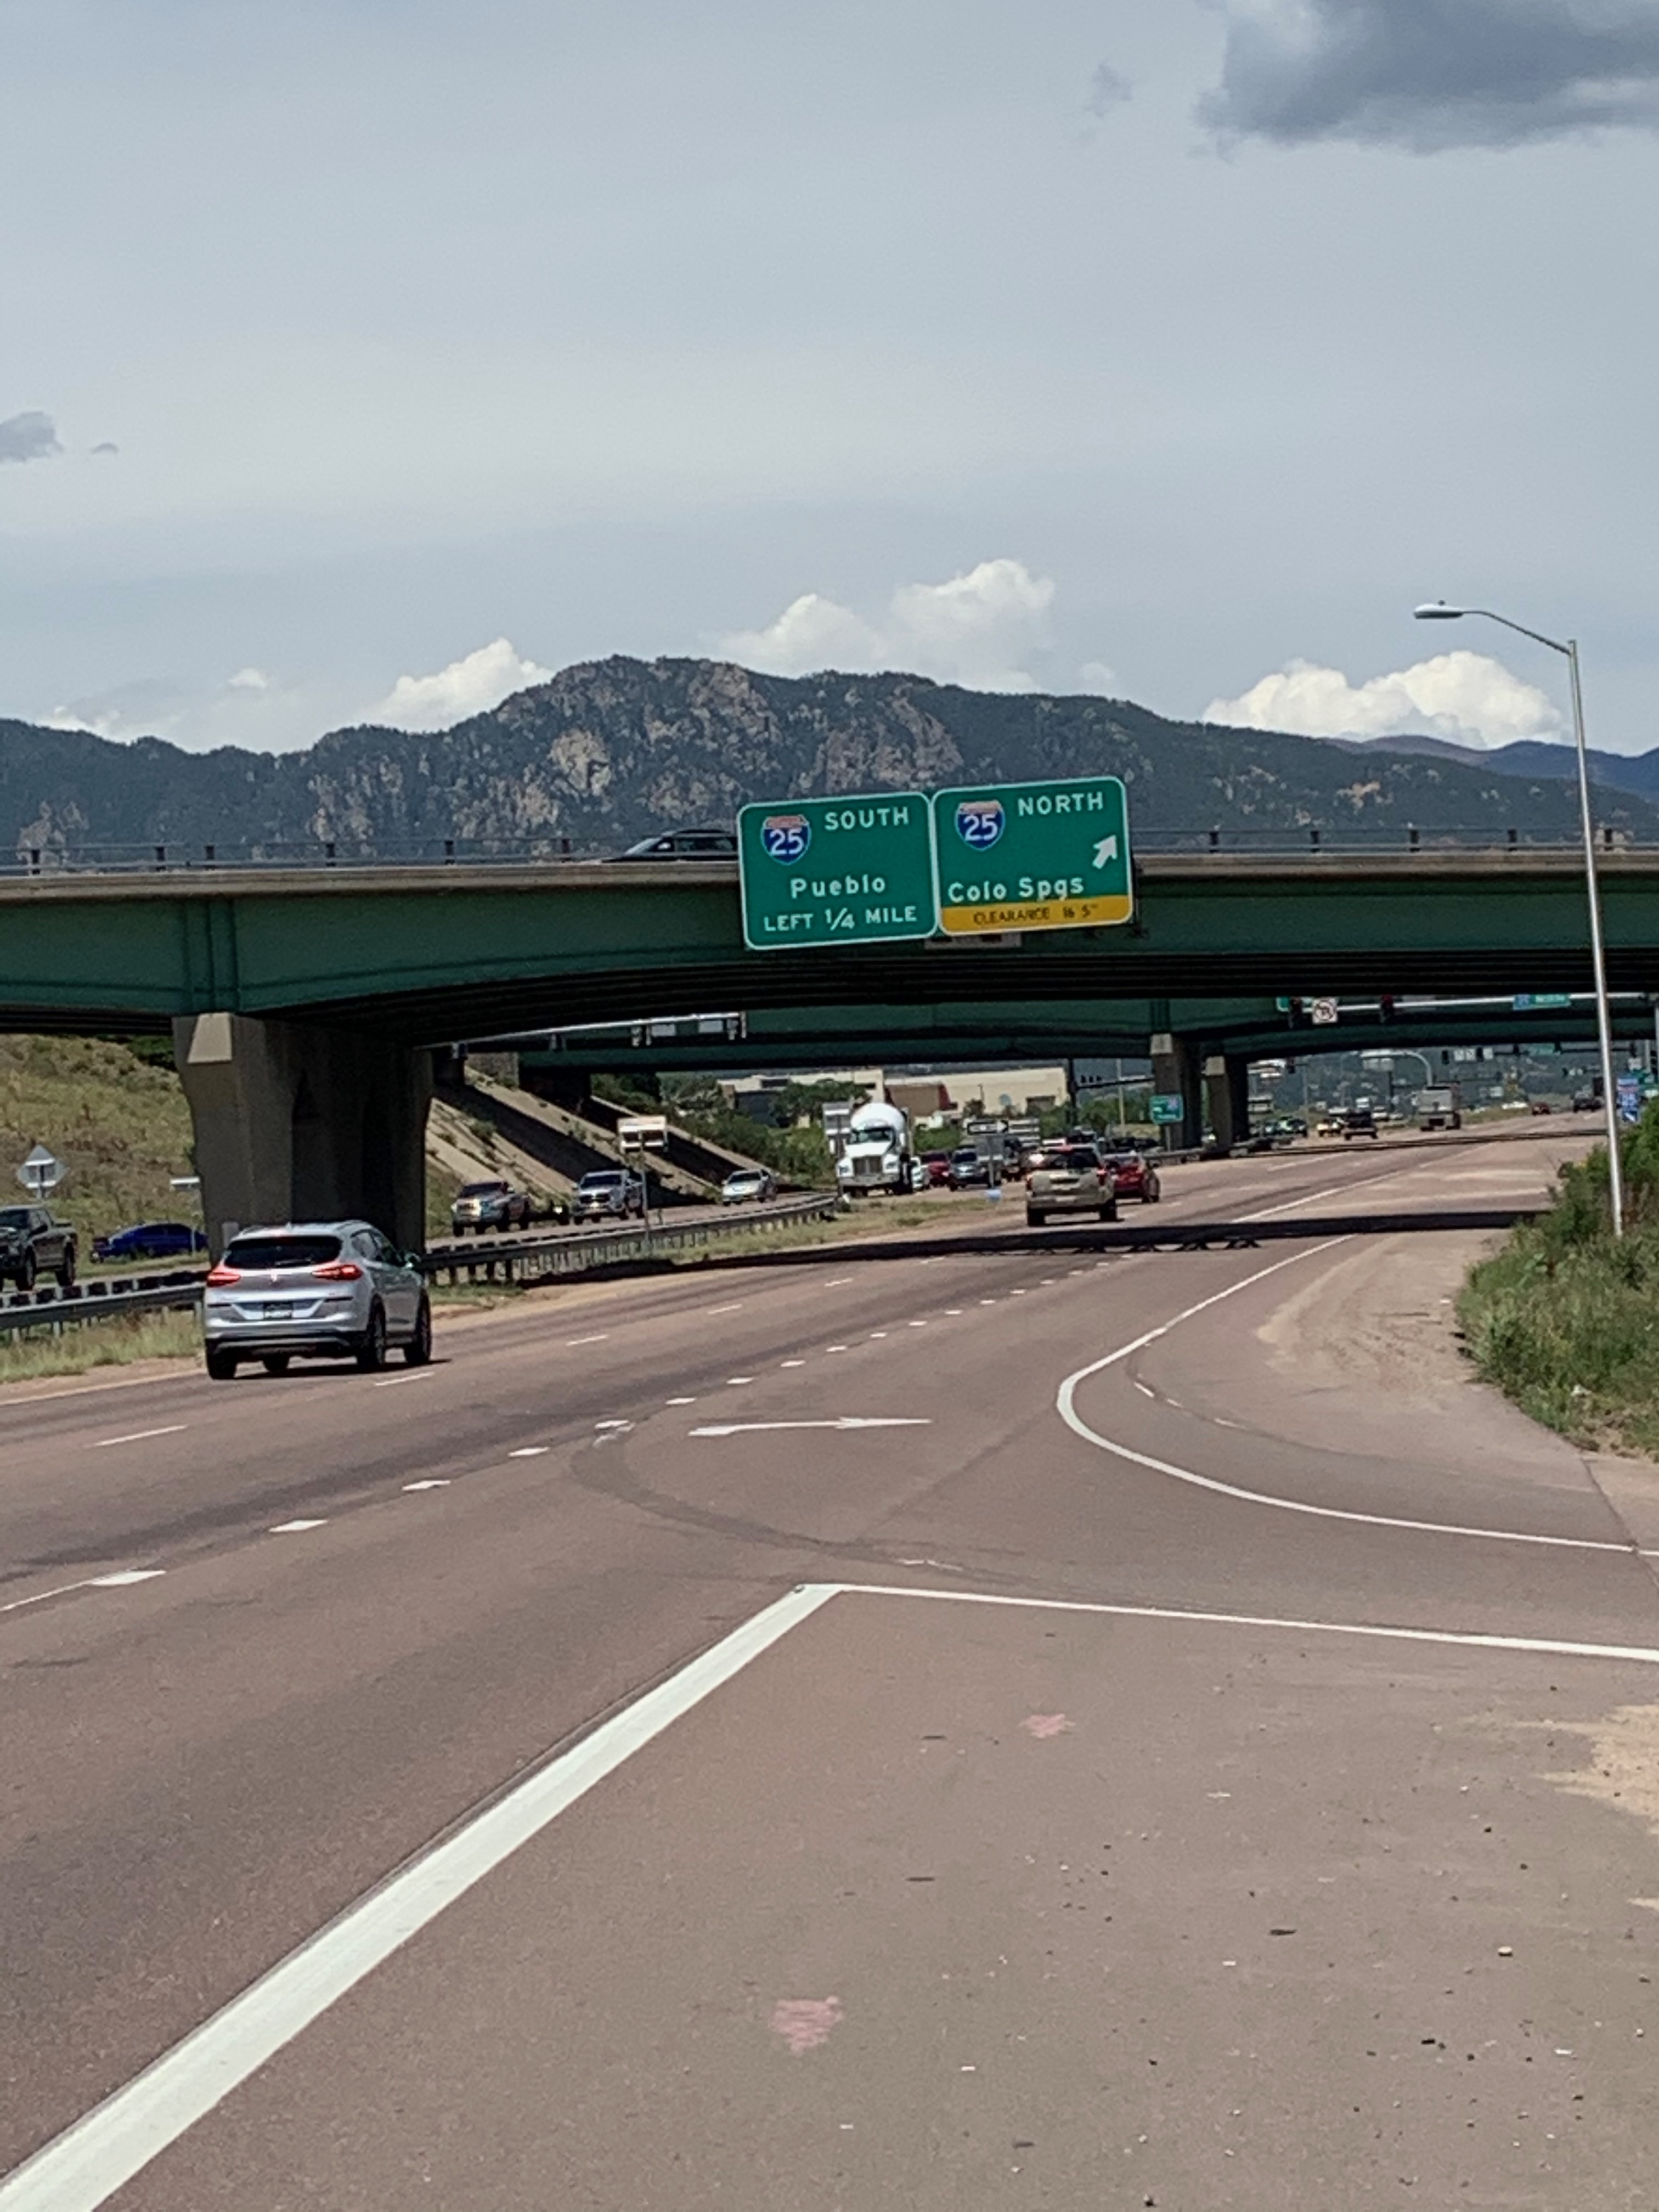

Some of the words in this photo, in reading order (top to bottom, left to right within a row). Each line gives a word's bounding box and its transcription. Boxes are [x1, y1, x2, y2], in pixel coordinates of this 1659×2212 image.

[963, 813, 998, 842] 25
[1017, 791, 1103, 817] NORTH
[769, 828, 805, 856] 25
[825, 806, 909, 831] SOUTH
[790, 874, 886, 899] Pueblo
[947, 880, 1007, 903] Colo
[1018, 877, 1084, 901] Spgs
[764, 913, 814, 932] LEFT
[825, 907, 856, 931] 1/4
[865, 905, 917, 924] MILE
[973, 907, 1050, 926] CLEARANCE
